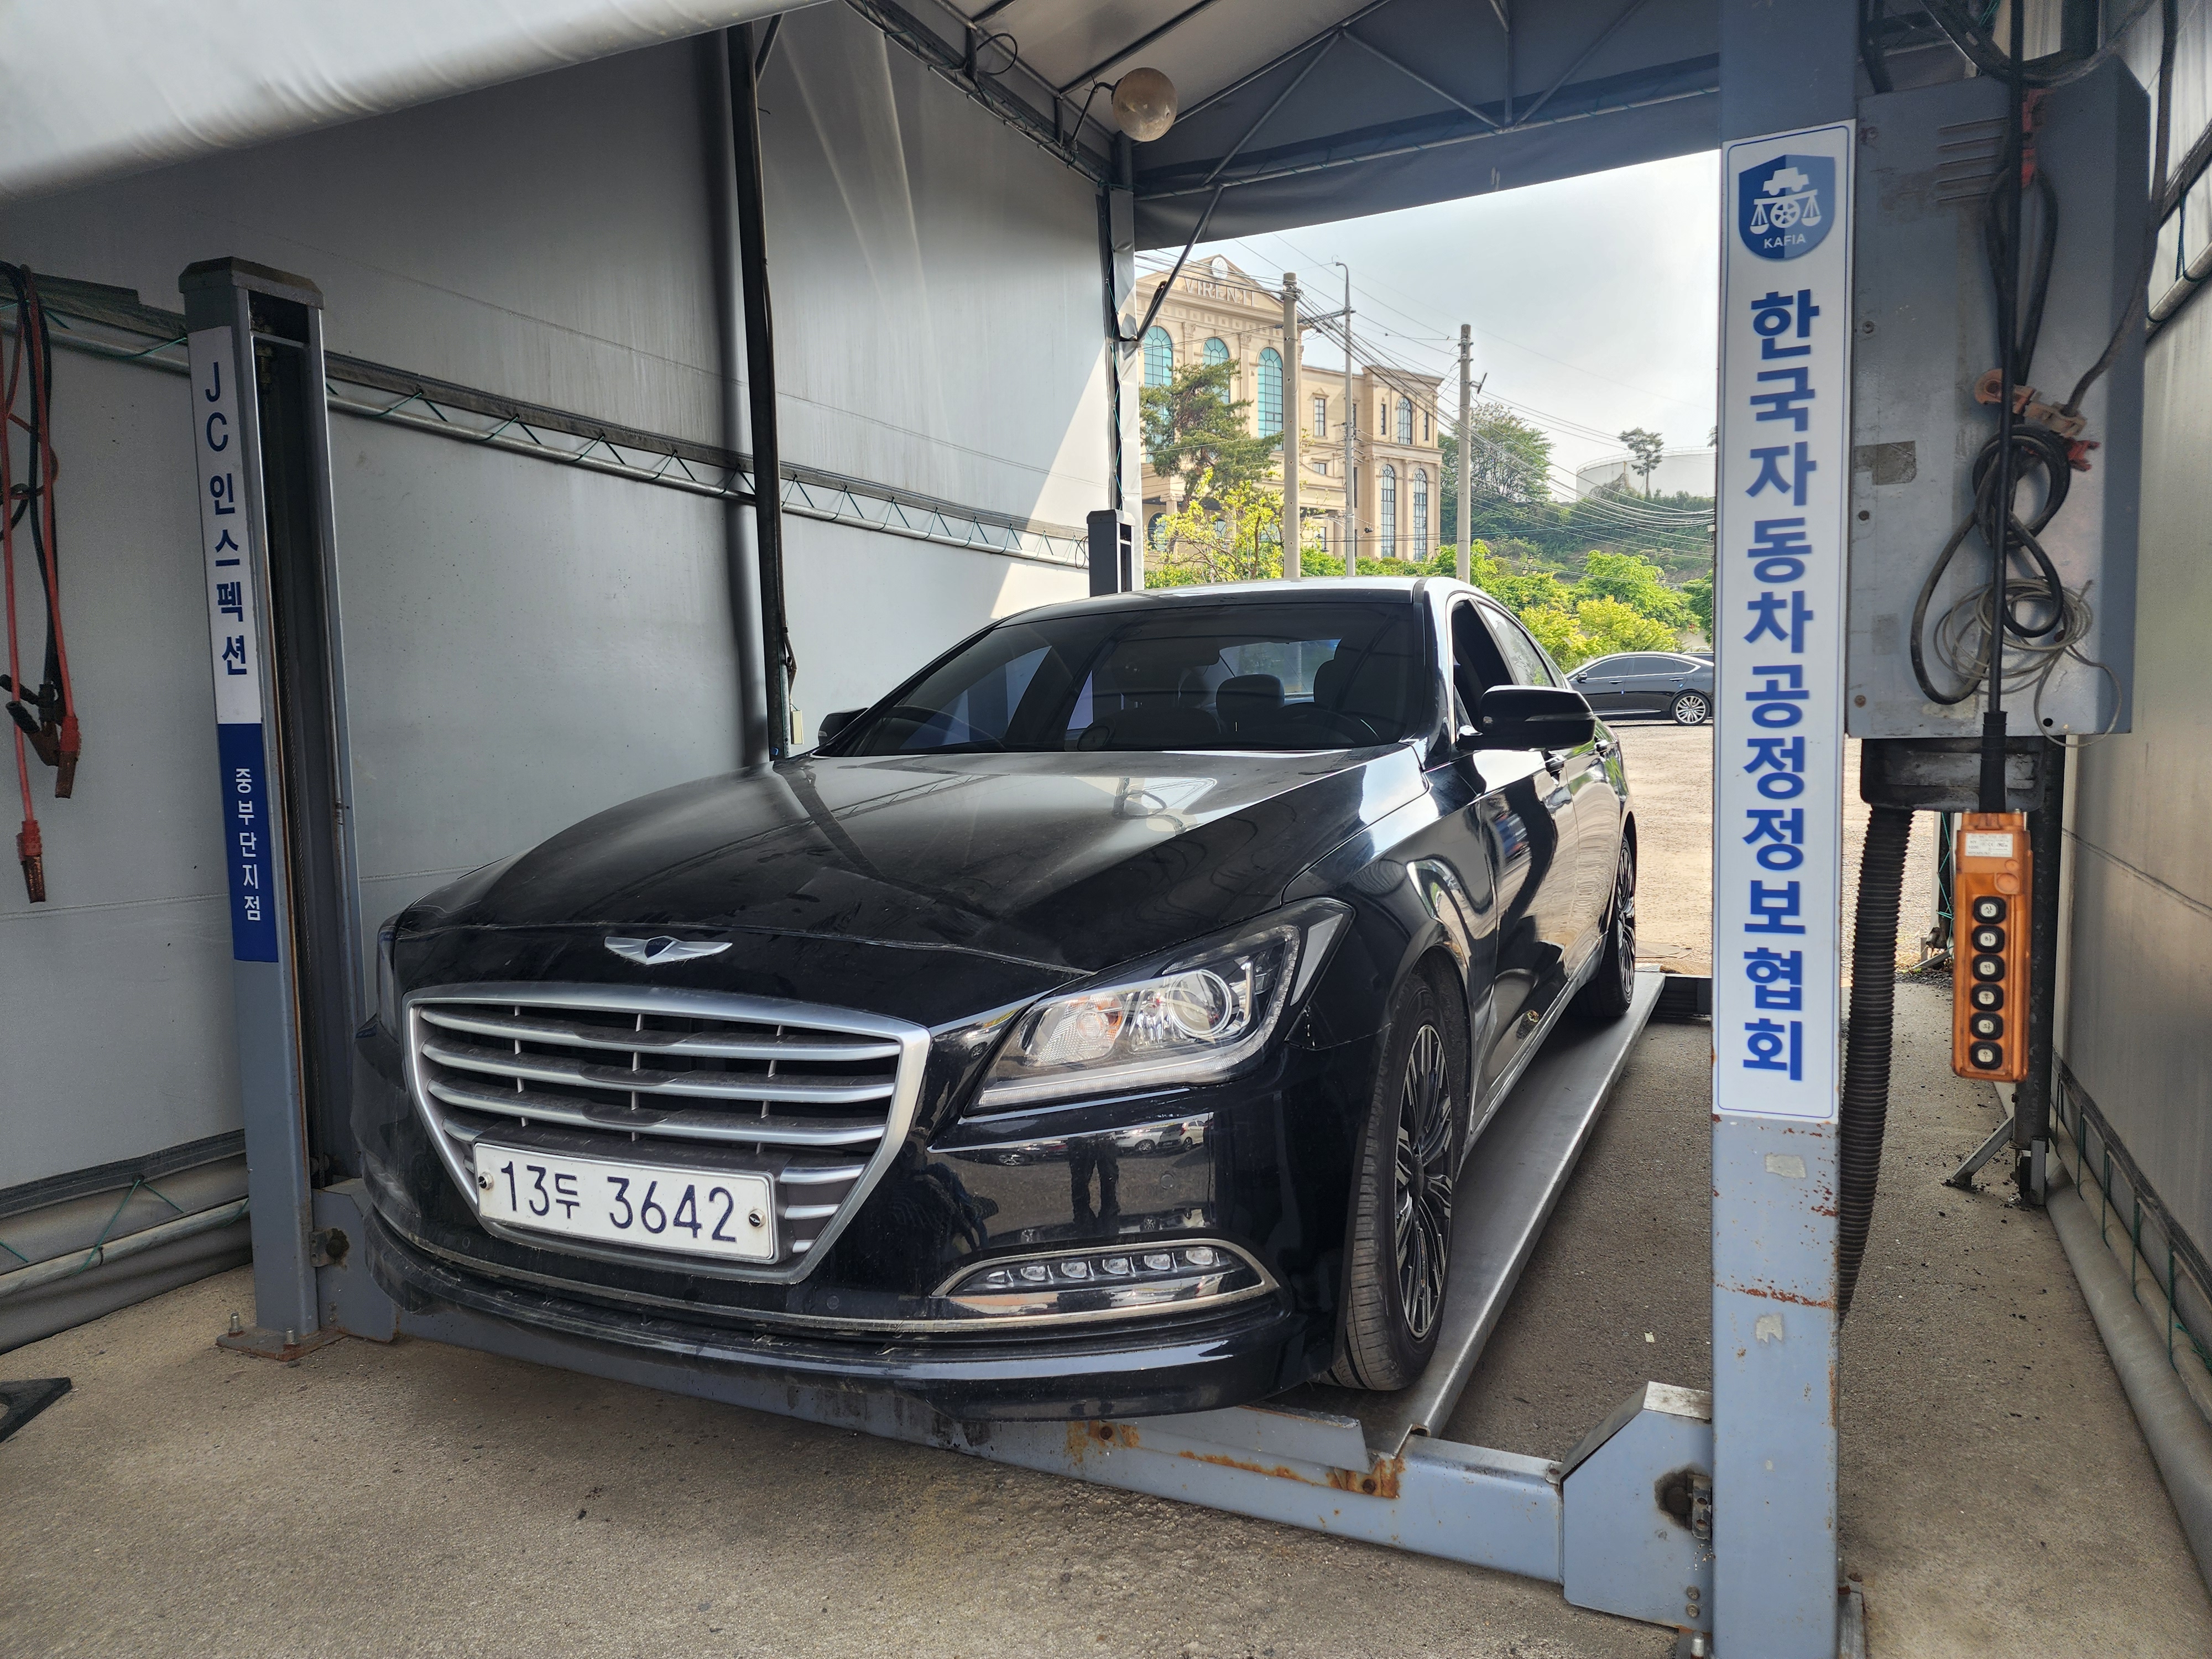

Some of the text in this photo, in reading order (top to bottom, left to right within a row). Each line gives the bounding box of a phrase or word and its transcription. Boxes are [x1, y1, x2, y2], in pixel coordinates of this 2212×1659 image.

[1764, 233, 1807, 249] KAFIA
[1183, 274, 1255, 307] VIRENTI
[1743, 289, 1819, 1082] 한국자동차공정정보협회
[234, 768, 262, 921] 중부단지점
[1984, 905, 1993, 914] 상
[1984, 935, 1992, 943] 하
[1981, 1051, 1990, 1060] 우
[500, 1161, 737, 1243] 13두 3642
